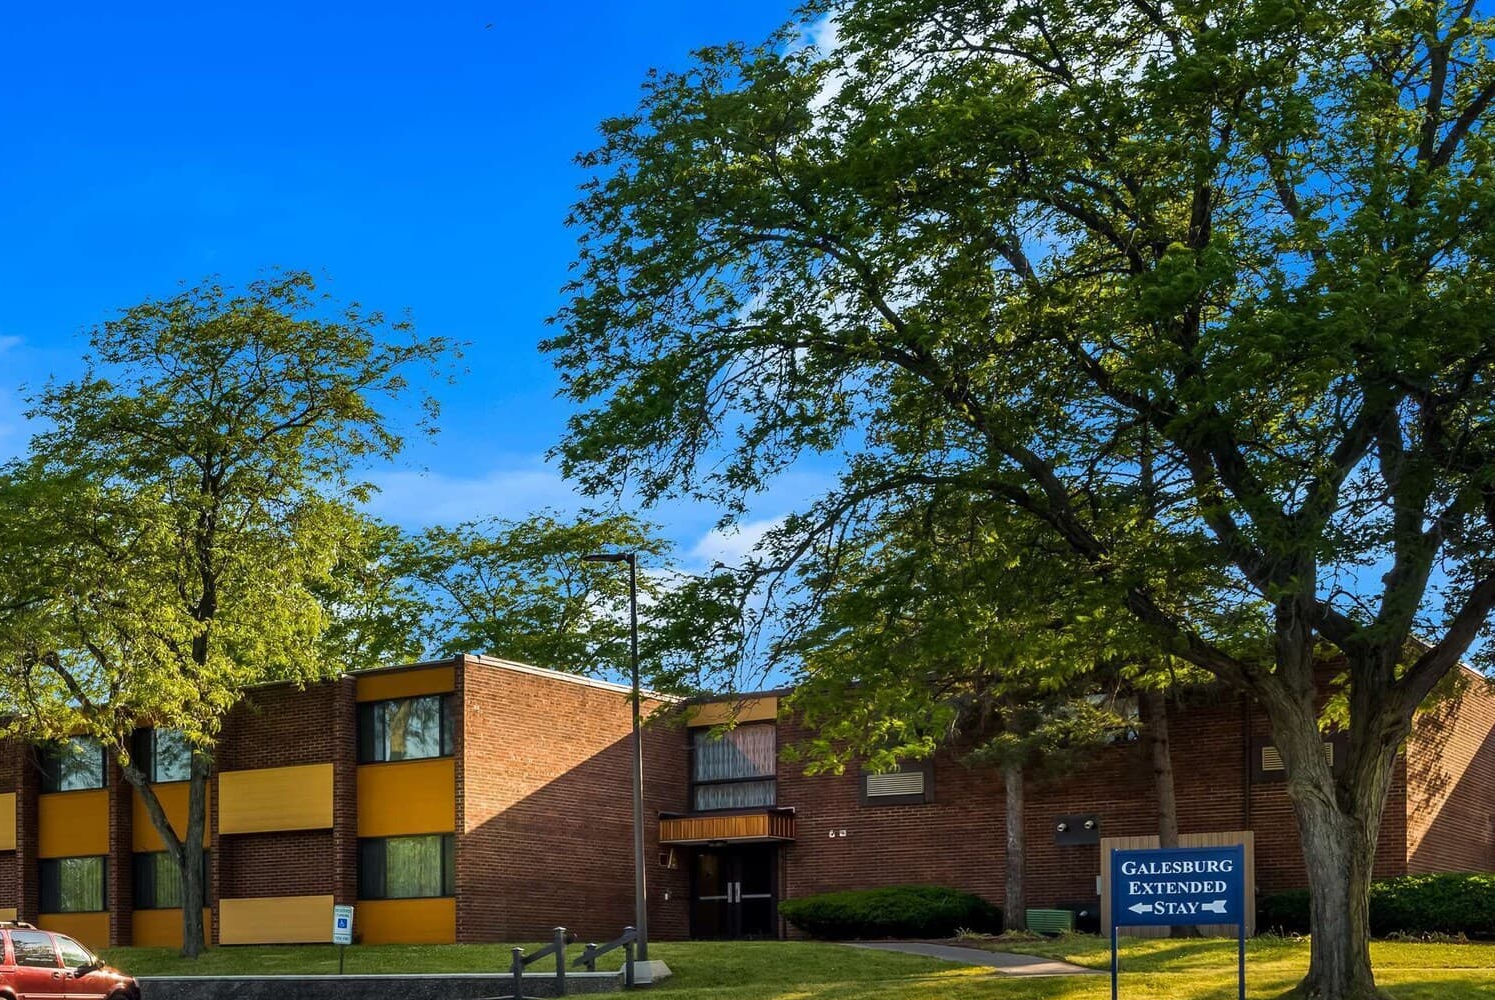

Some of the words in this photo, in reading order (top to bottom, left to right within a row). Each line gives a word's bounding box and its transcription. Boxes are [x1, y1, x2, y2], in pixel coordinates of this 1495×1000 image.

[1121, 859, 1233, 876] GALESBURG
[1128, 880, 1227, 896] EXTENDED
[1153, 900, 1200, 916] STAY
